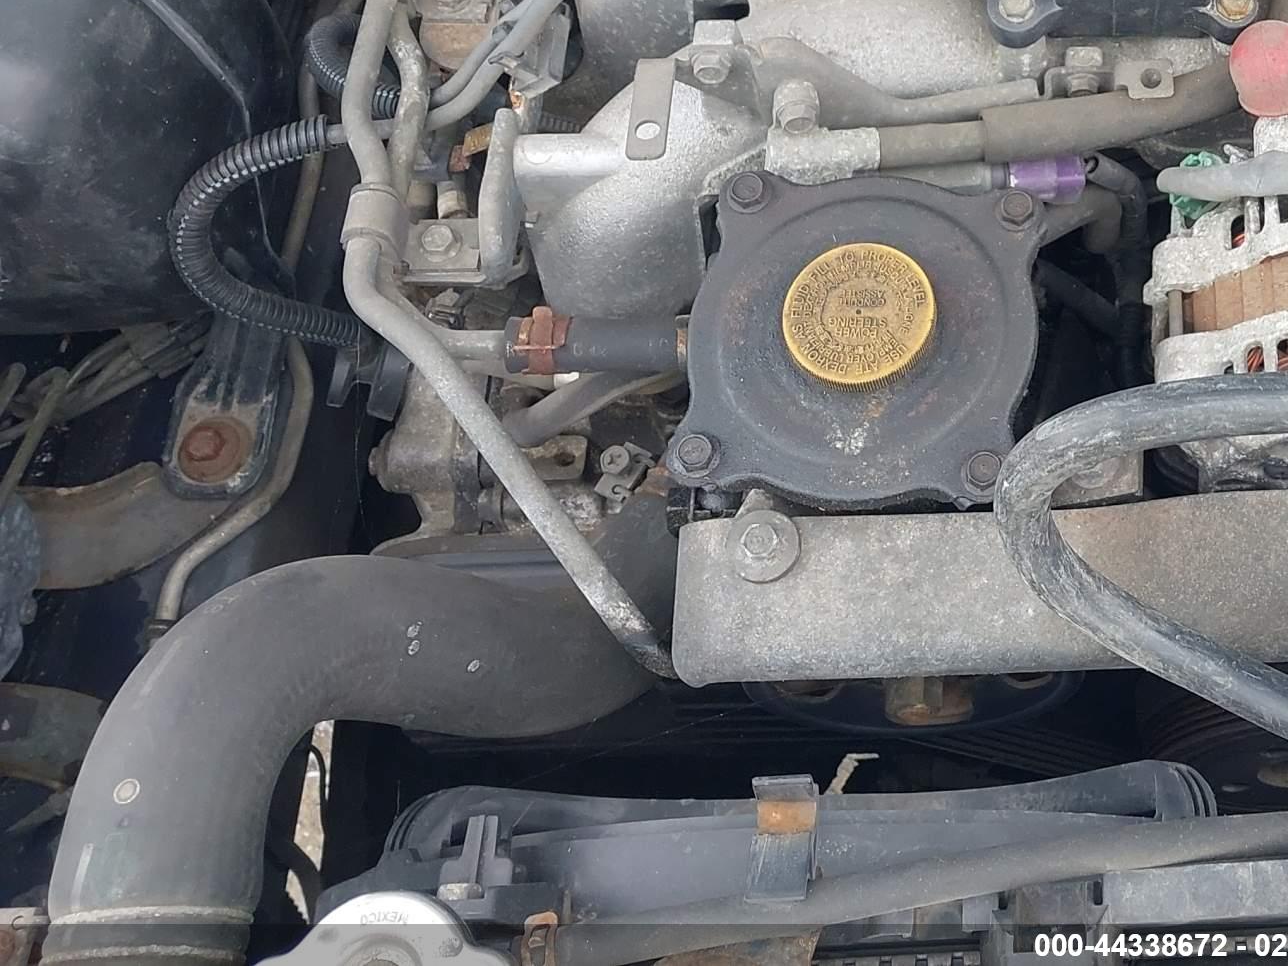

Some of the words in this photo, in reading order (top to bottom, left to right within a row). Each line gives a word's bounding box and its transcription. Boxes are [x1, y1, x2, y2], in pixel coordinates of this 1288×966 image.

[791, 280, 811, 319] FLUID
[906, 272, 927, 309] LEVEL
[791, 323, 807, 340] AS
[829, 316, 887, 329] STEERING
[835, 326, 879, 339] POWER
[800, 341, 848, 375] DEXRON
[887, 343, 908, 364] USE
[360, 910, 409, 926] MEXICO
